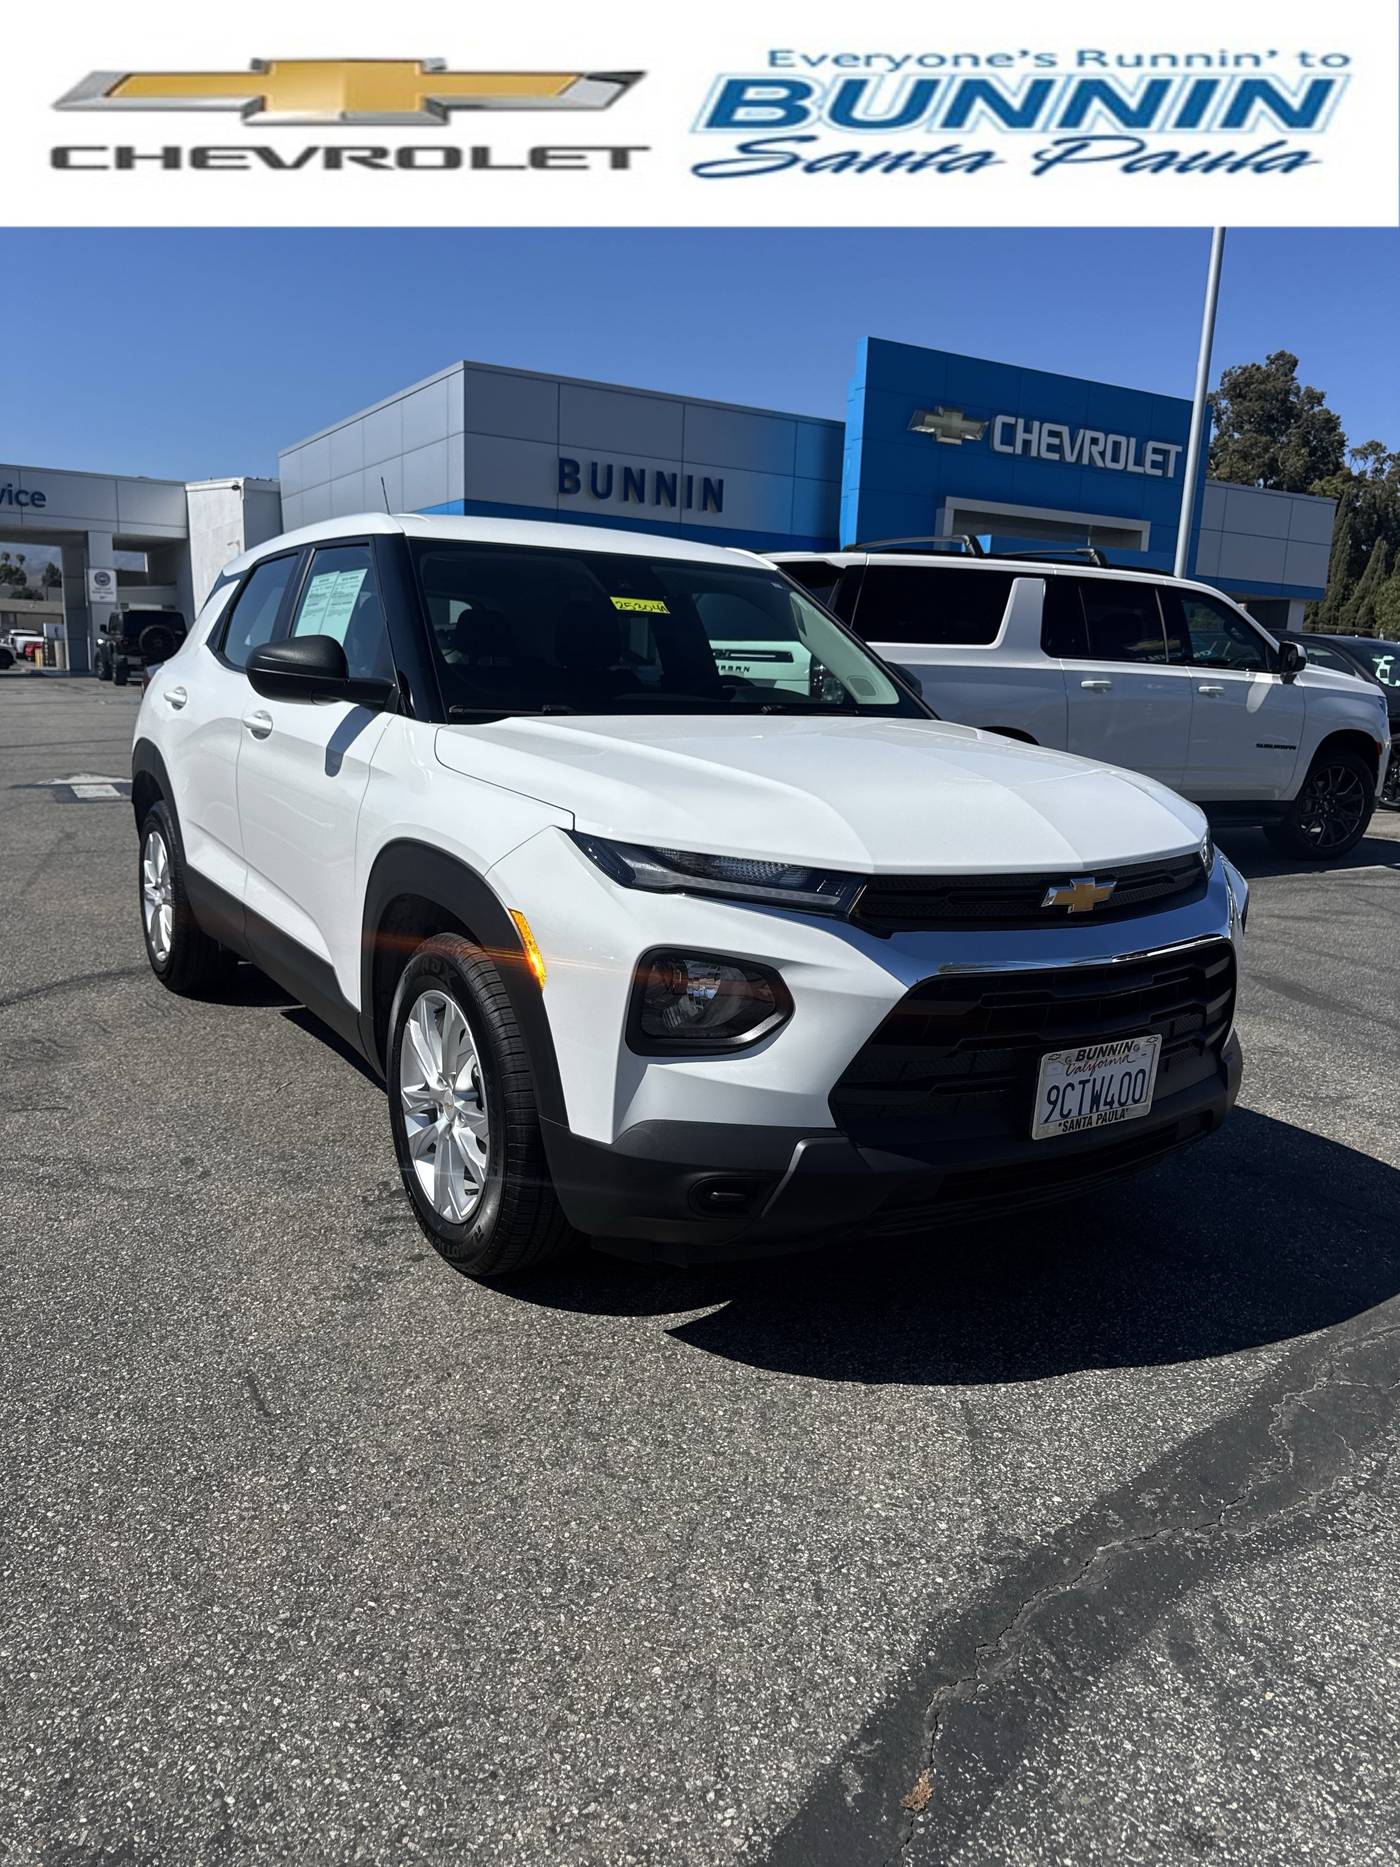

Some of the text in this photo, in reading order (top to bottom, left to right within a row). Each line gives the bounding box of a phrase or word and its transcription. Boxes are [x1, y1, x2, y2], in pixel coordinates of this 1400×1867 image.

[991, 414, 1183, 478] CHEVROLET
[557, 456, 724, 513] BUNNIN
[1065, 1054, 1136, 1077] California
[1074, 1040, 1135, 1062] BUNNIN
[1044, 1068, 1147, 1123] 9CTW400
